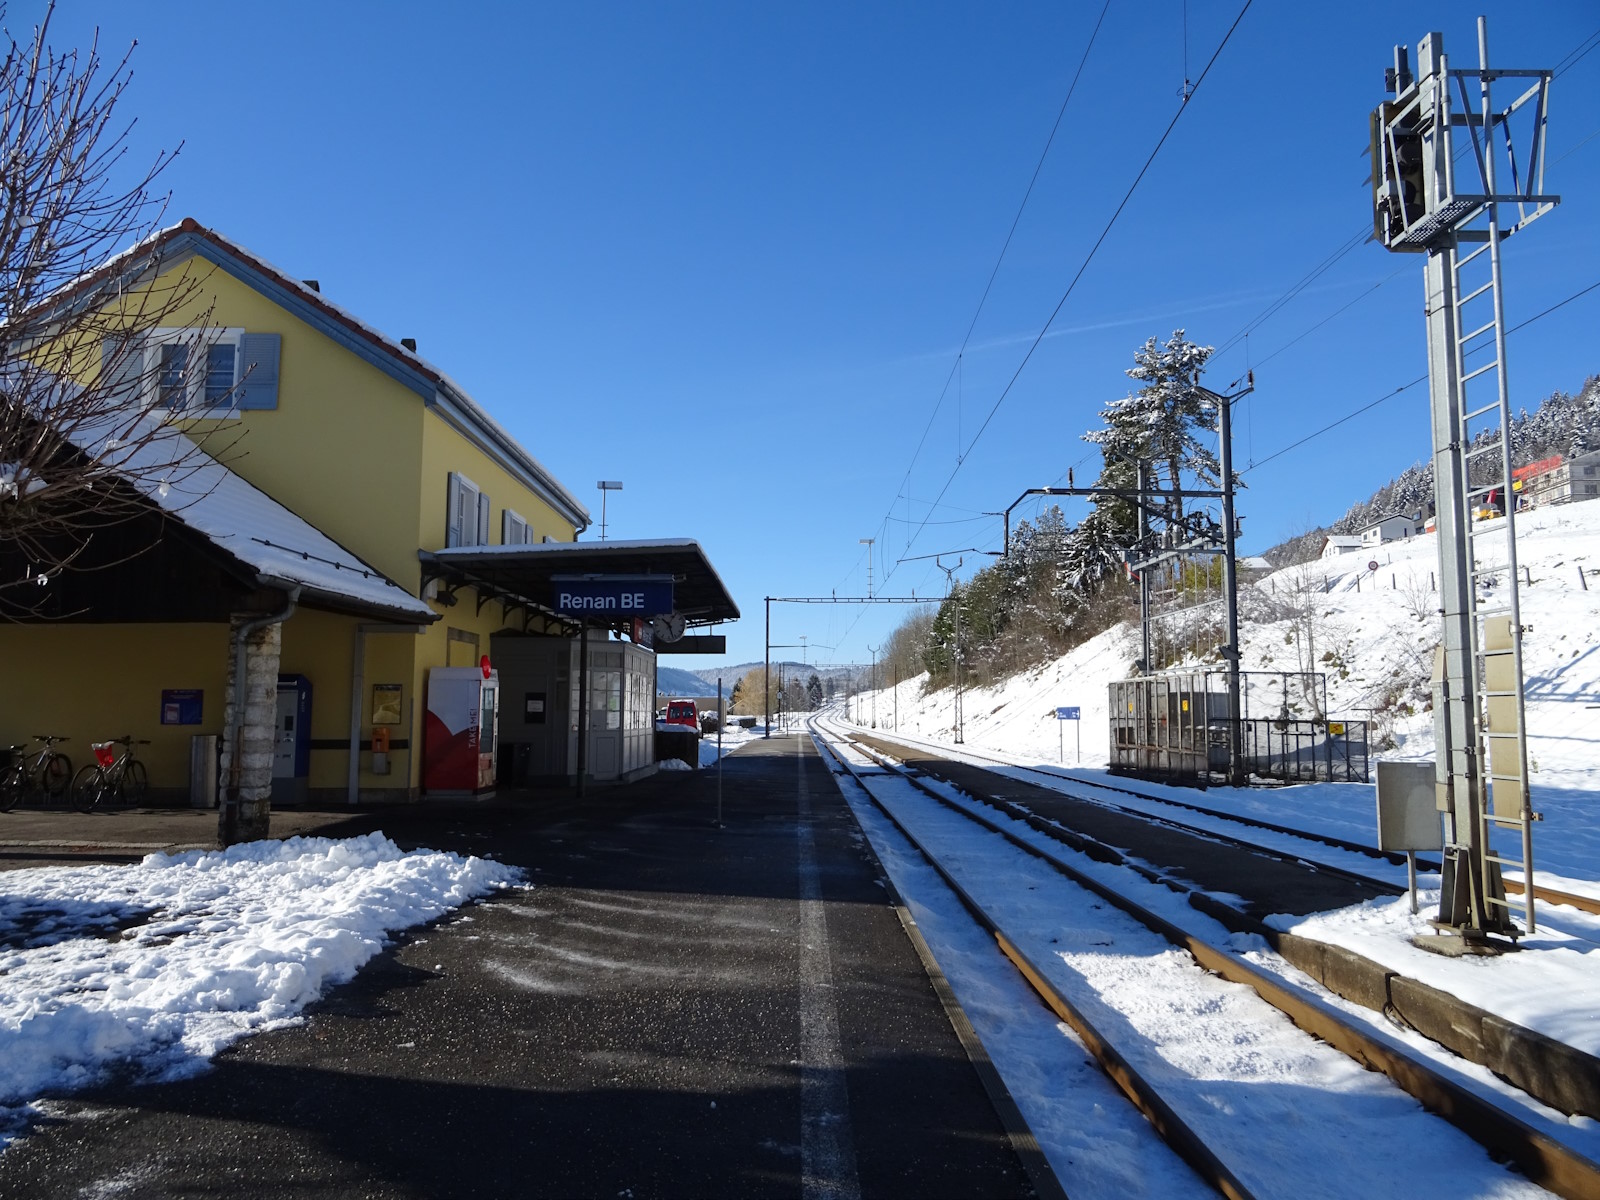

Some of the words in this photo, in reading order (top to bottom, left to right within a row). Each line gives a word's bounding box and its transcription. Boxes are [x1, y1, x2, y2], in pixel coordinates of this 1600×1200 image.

[559, 593, 616, 609] Renan
[620, 593, 645, 609] BE
[468, 725, 477, 748] TAKE
